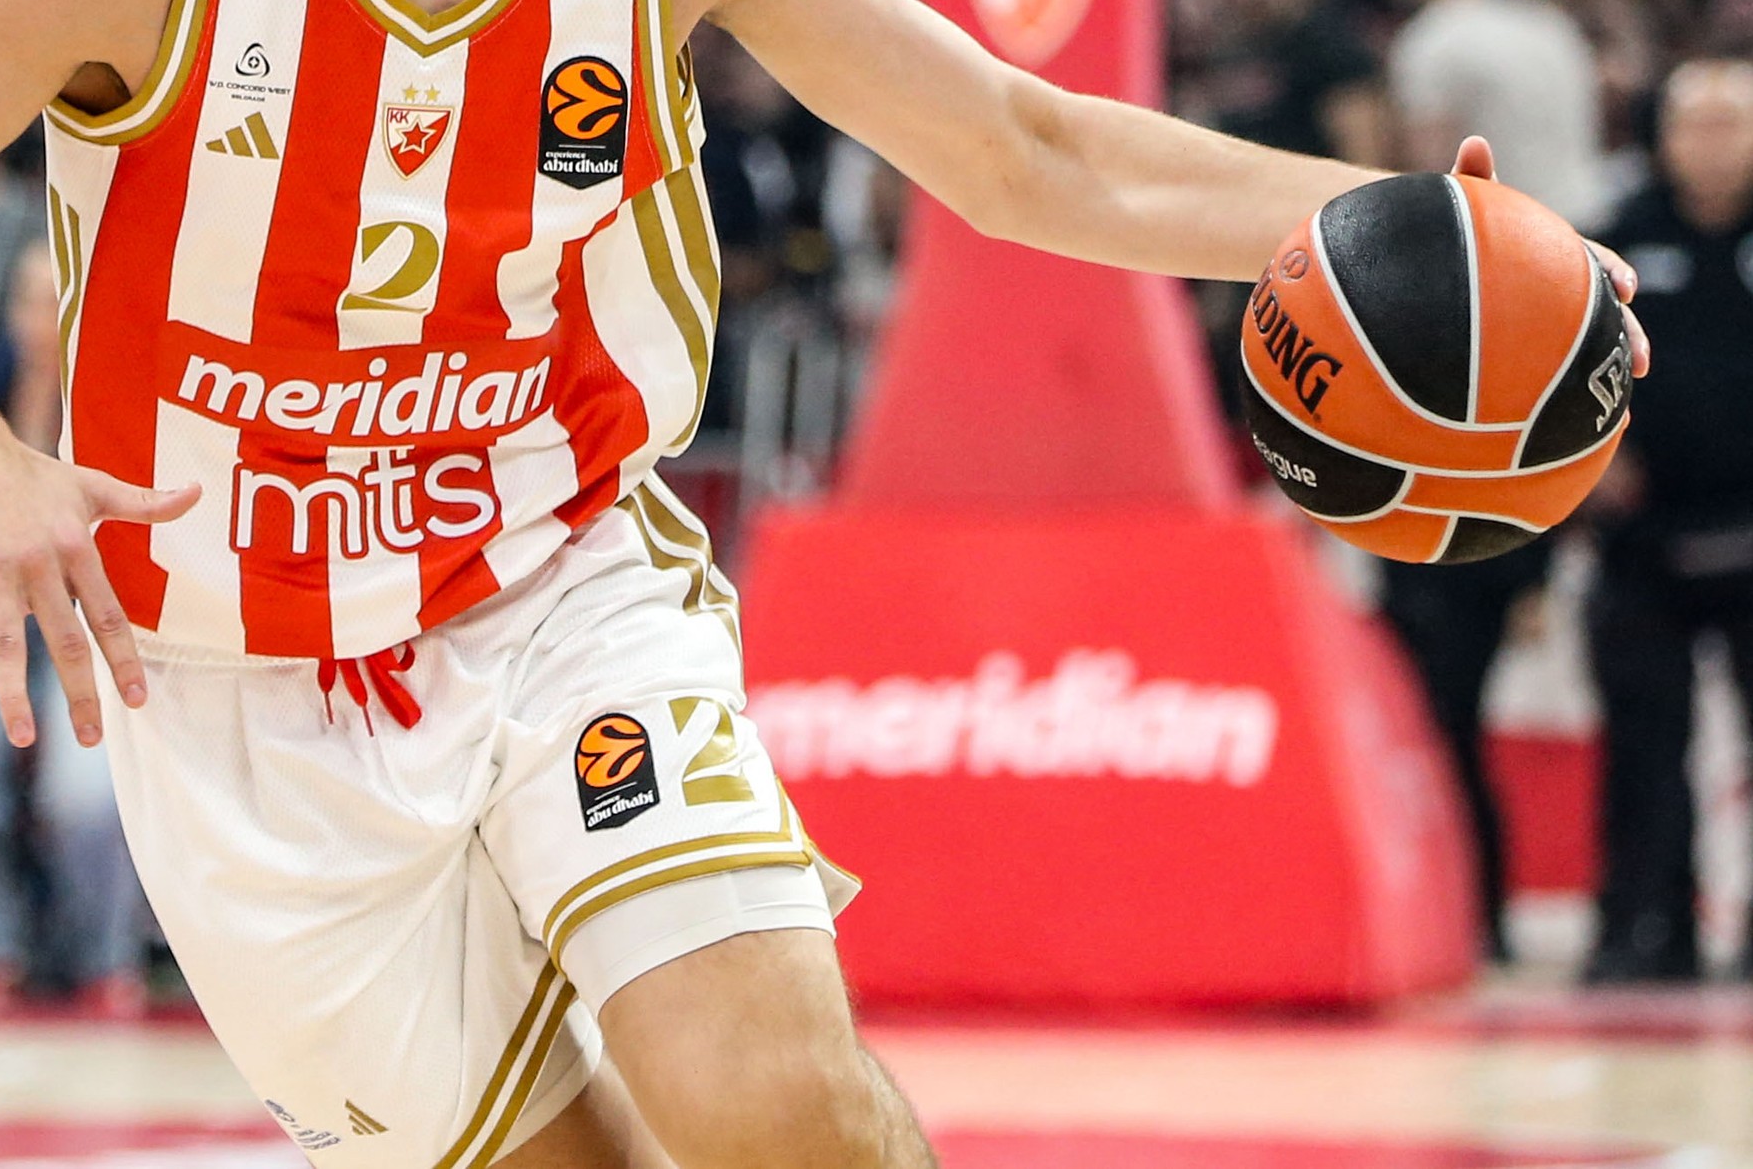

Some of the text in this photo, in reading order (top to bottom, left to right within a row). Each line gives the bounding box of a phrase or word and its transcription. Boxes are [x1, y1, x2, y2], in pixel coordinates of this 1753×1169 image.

[226, 82, 266, 93] CONCORD
[268, 87, 291, 95] WEST
[390, 111, 409, 124] KK
[543, 158, 619, 173] abu dhabi
[341, 221, 439, 310] 2
[177, 351, 550, 436] meridian
[234, 447, 498, 556] mts
[668, 696, 756, 807] 2
[587, 807, 612, 827] abu
[612, 790, 654, 814] dhabi
